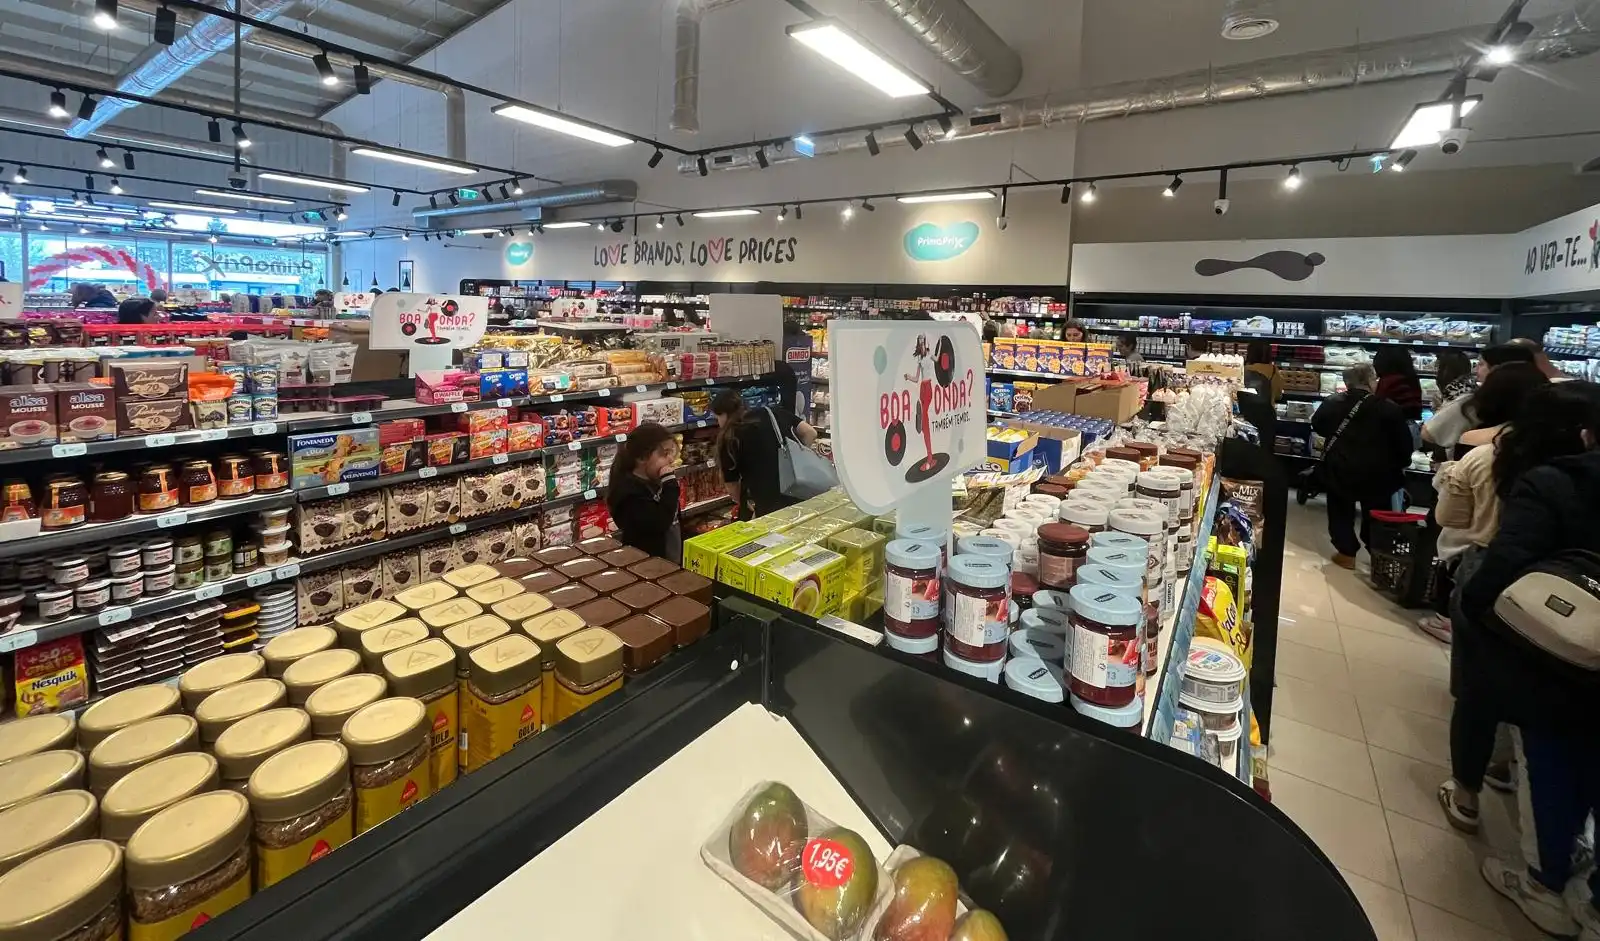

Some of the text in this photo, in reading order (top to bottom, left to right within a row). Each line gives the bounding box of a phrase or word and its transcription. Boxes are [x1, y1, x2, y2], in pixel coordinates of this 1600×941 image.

[633, 241, 685, 266] BRANDS,
[738, 237, 797, 264] PRICES
[1524, 247, 1537, 275] AO
[399, 312, 476, 327] BOA ONDA?
[788, 350, 809, 360] BIMBO
[9, 395, 49, 408] alsa
[69, 391, 106, 404] alsa
[880, 368, 974, 430] BOA ONDA?
[11, 405, 47, 414] MOUSSE
[71, 402, 105, 410] MOUSSE
[931, 413, 954, 433] TAMBÉM
[296, 437, 335, 447] FONTANEDA
[342, 469, 378, 480] FONTANEDA
[1232, 491, 1253, 501] Choco
[1239, 485, 1259, 496] Mix
[31, 670, 77, 690] Nesquik
[518, 721, 535, 739] GOLD
[809, 843, 849, 879] 1,95€
